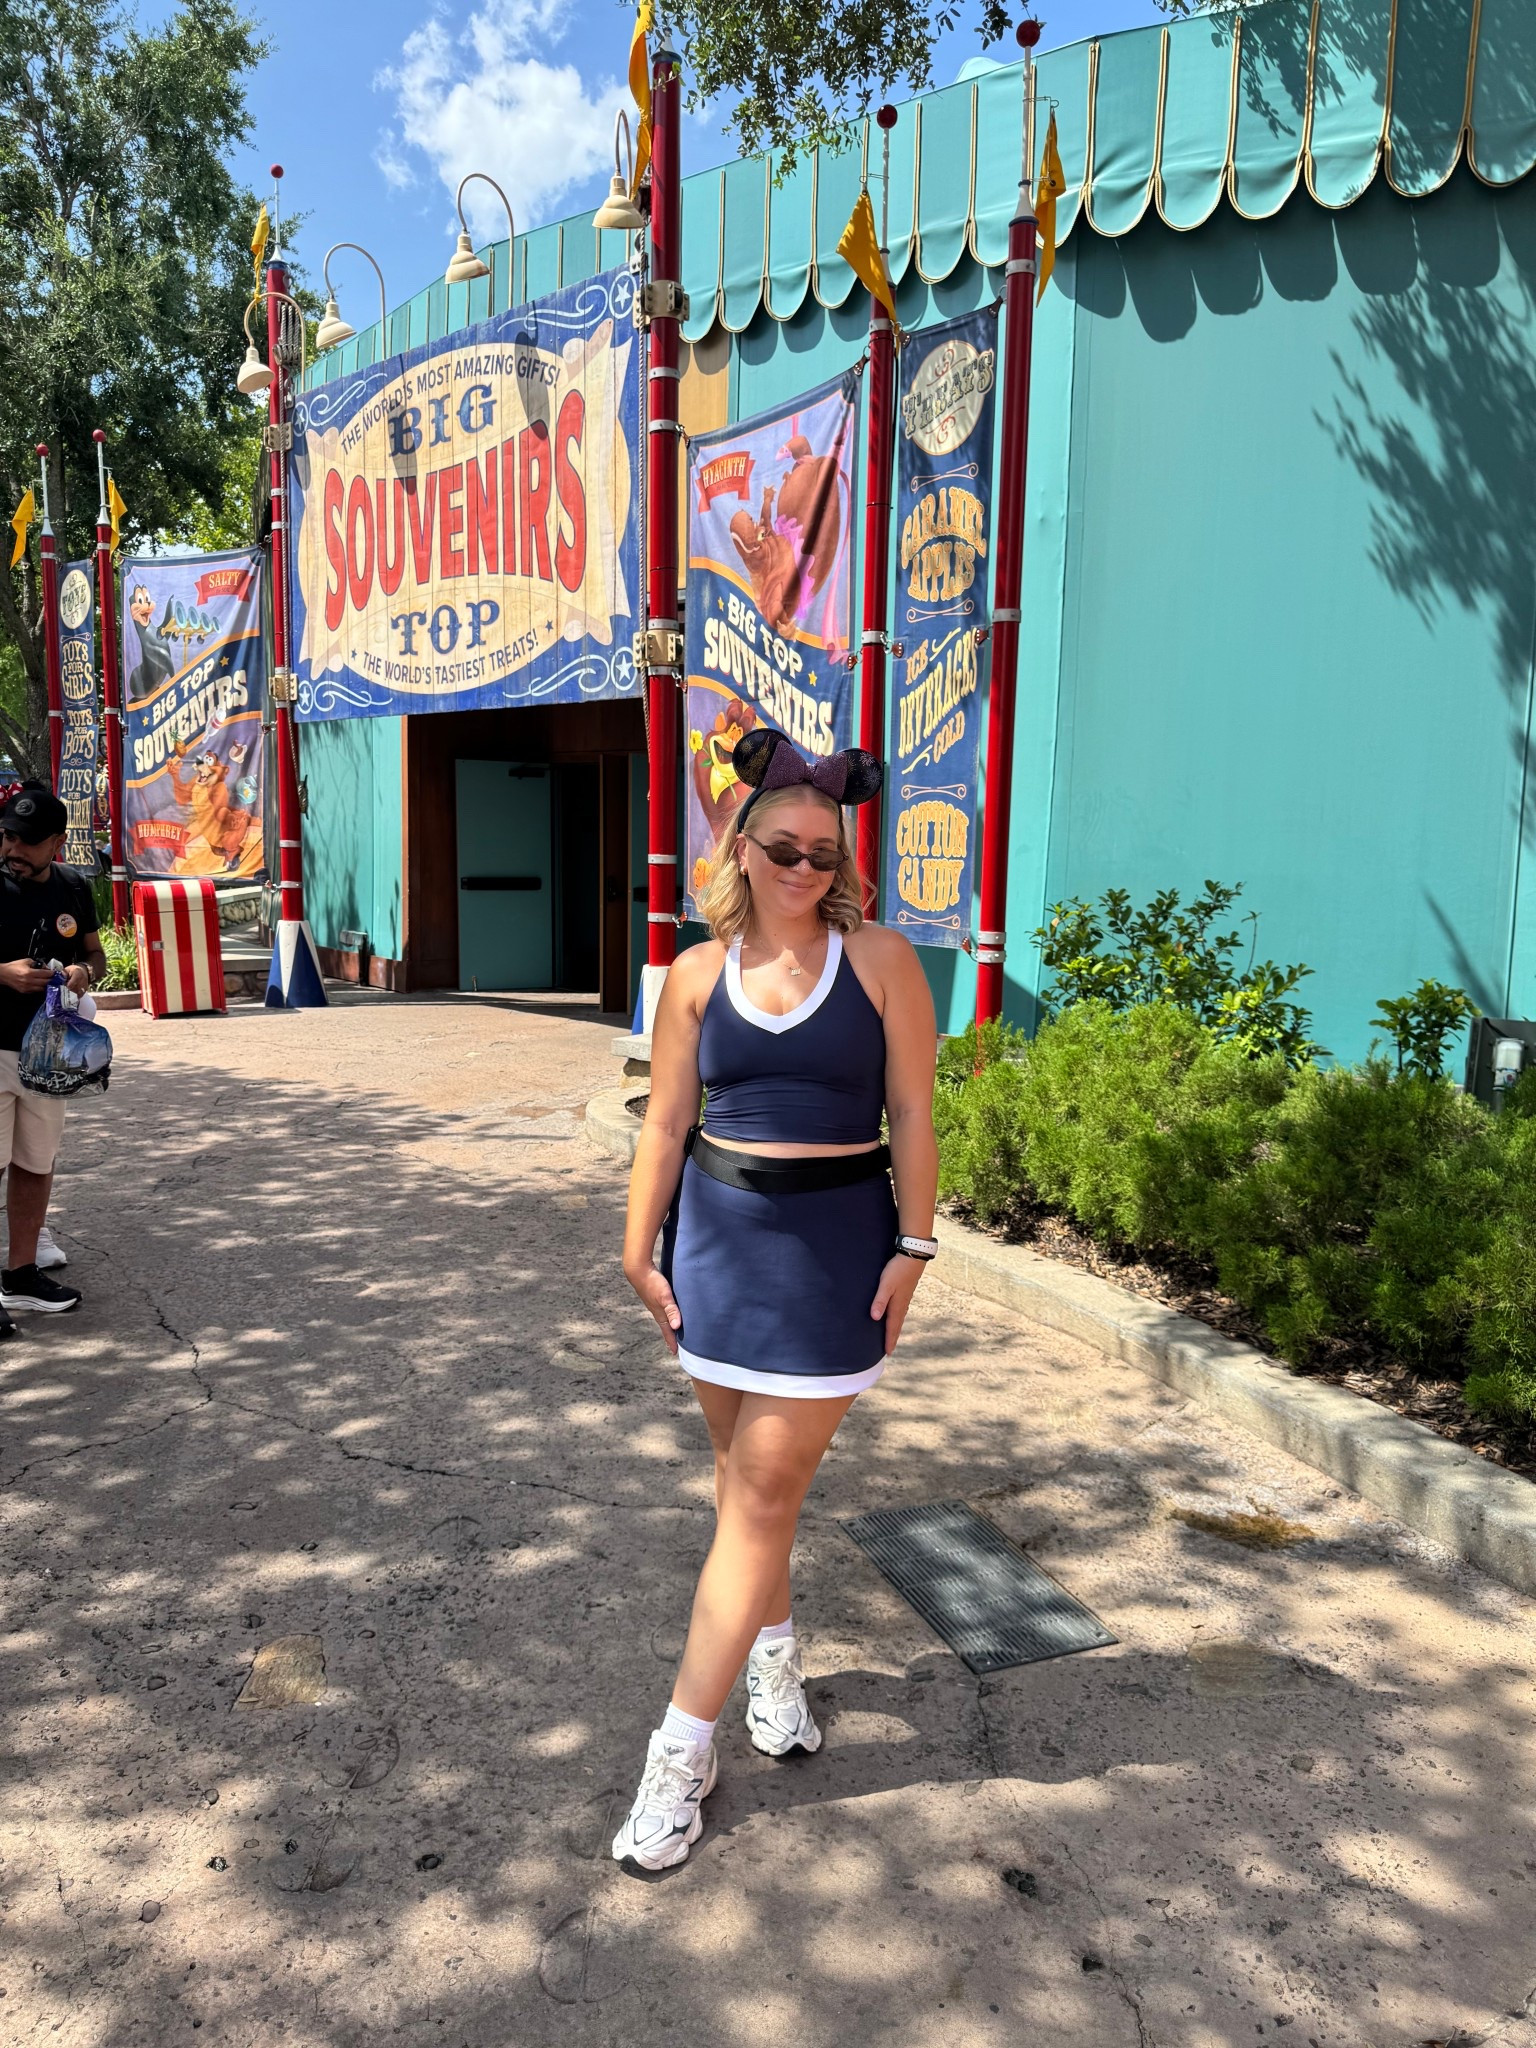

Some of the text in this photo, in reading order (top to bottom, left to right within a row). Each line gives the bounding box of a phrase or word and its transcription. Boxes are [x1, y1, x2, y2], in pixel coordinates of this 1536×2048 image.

[341, 355, 561, 455] THE WORLD'S MOST AMAZING GIFTS!
[388, 381, 497, 457] BIG
[902, 349, 995, 439] TREATS
[702, 456, 747, 490] HYACINTH
[324, 388, 587, 632] SOUVENIRS
[901, 486, 987, 569] CARAMEL
[208, 571, 241, 589] SALTY
[908, 542, 975, 602] APPLES
[62, 640, 89, 662] TOYS
[390, 599, 500, 657] TOP
[727, 592, 803, 679] BIG TOP
[61, 662, 94, 700] GIRLS
[67, 661, 84, 674] FOR
[363, 628, 539, 685] THE WORLD'S TASTIEST TREATS!
[905, 638, 929, 686] ICE
[152, 658, 215, 726] BIG TOP
[703, 617, 834, 757] SOUVENIRS
[898, 627, 979, 759] BEVERAGES
[63, 730, 95, 760] BOYS
[67, 708, 93, 727] TOYS
[74, 726, 88, 735] FOR
[134, 669, 248, 773] SOUVENIRS
[933, 710, 965, 763] COLD
[61, 768, 92, 794] TOYS
[65, 844, 95, 866] AGES
[73, 830, 92, 844] ALL
[137, 823, 182, 841] HUMPHREY
[896, 800, 969, 858] COTTON
[897, 856, 964, 912] CANDY
